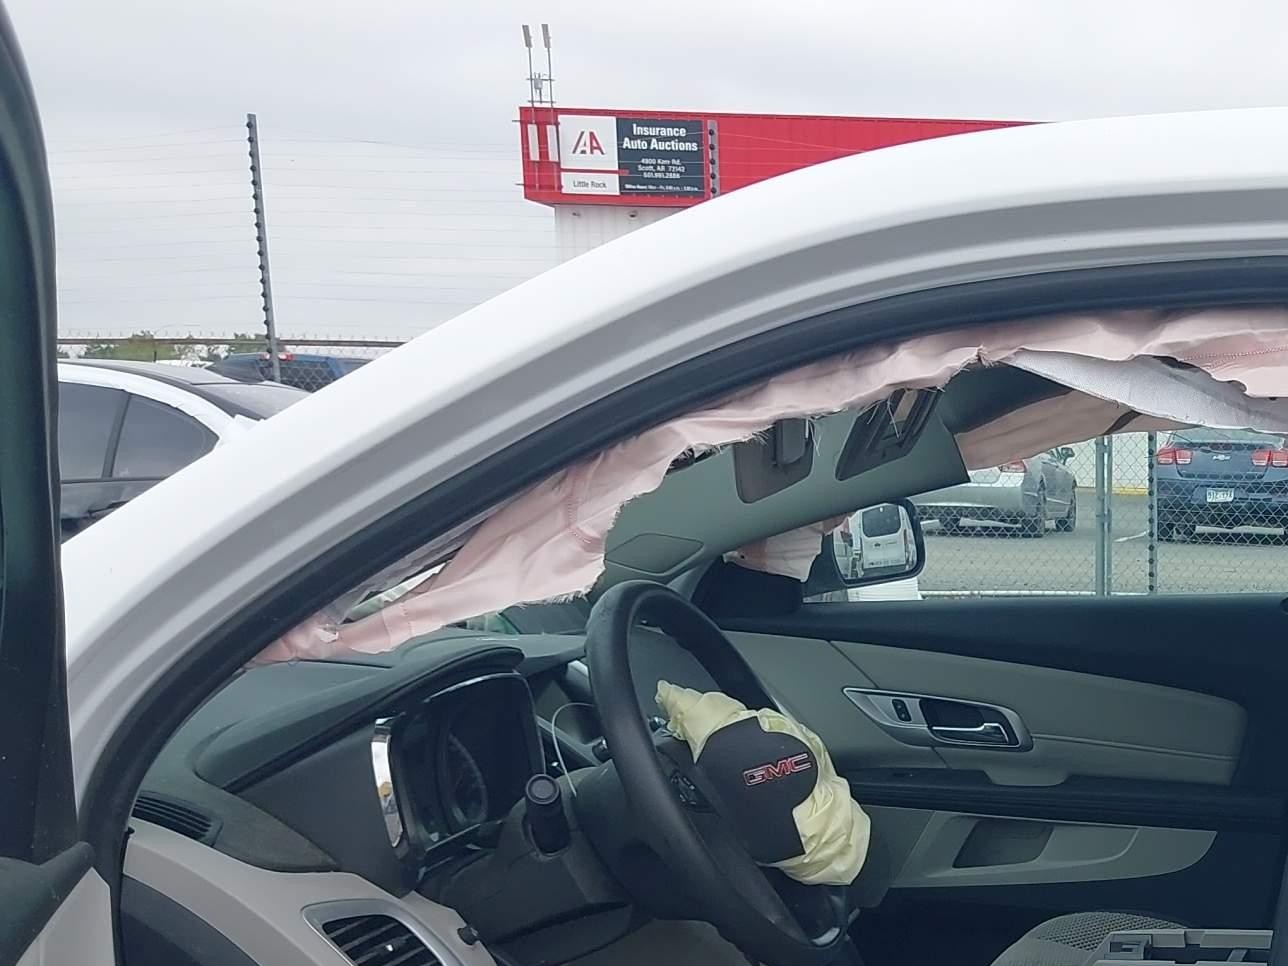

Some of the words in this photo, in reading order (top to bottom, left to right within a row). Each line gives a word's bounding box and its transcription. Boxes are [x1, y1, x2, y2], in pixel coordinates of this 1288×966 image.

[632, 123, 687, 137] Insurance
[622, 137, 648, 150] Auto
[650, 138, 698, 151] Auctions
[637, 164, 656, 172] Scott,
[573, 180, 589, 188] Little
[743, 752, 812, 787] GMC
